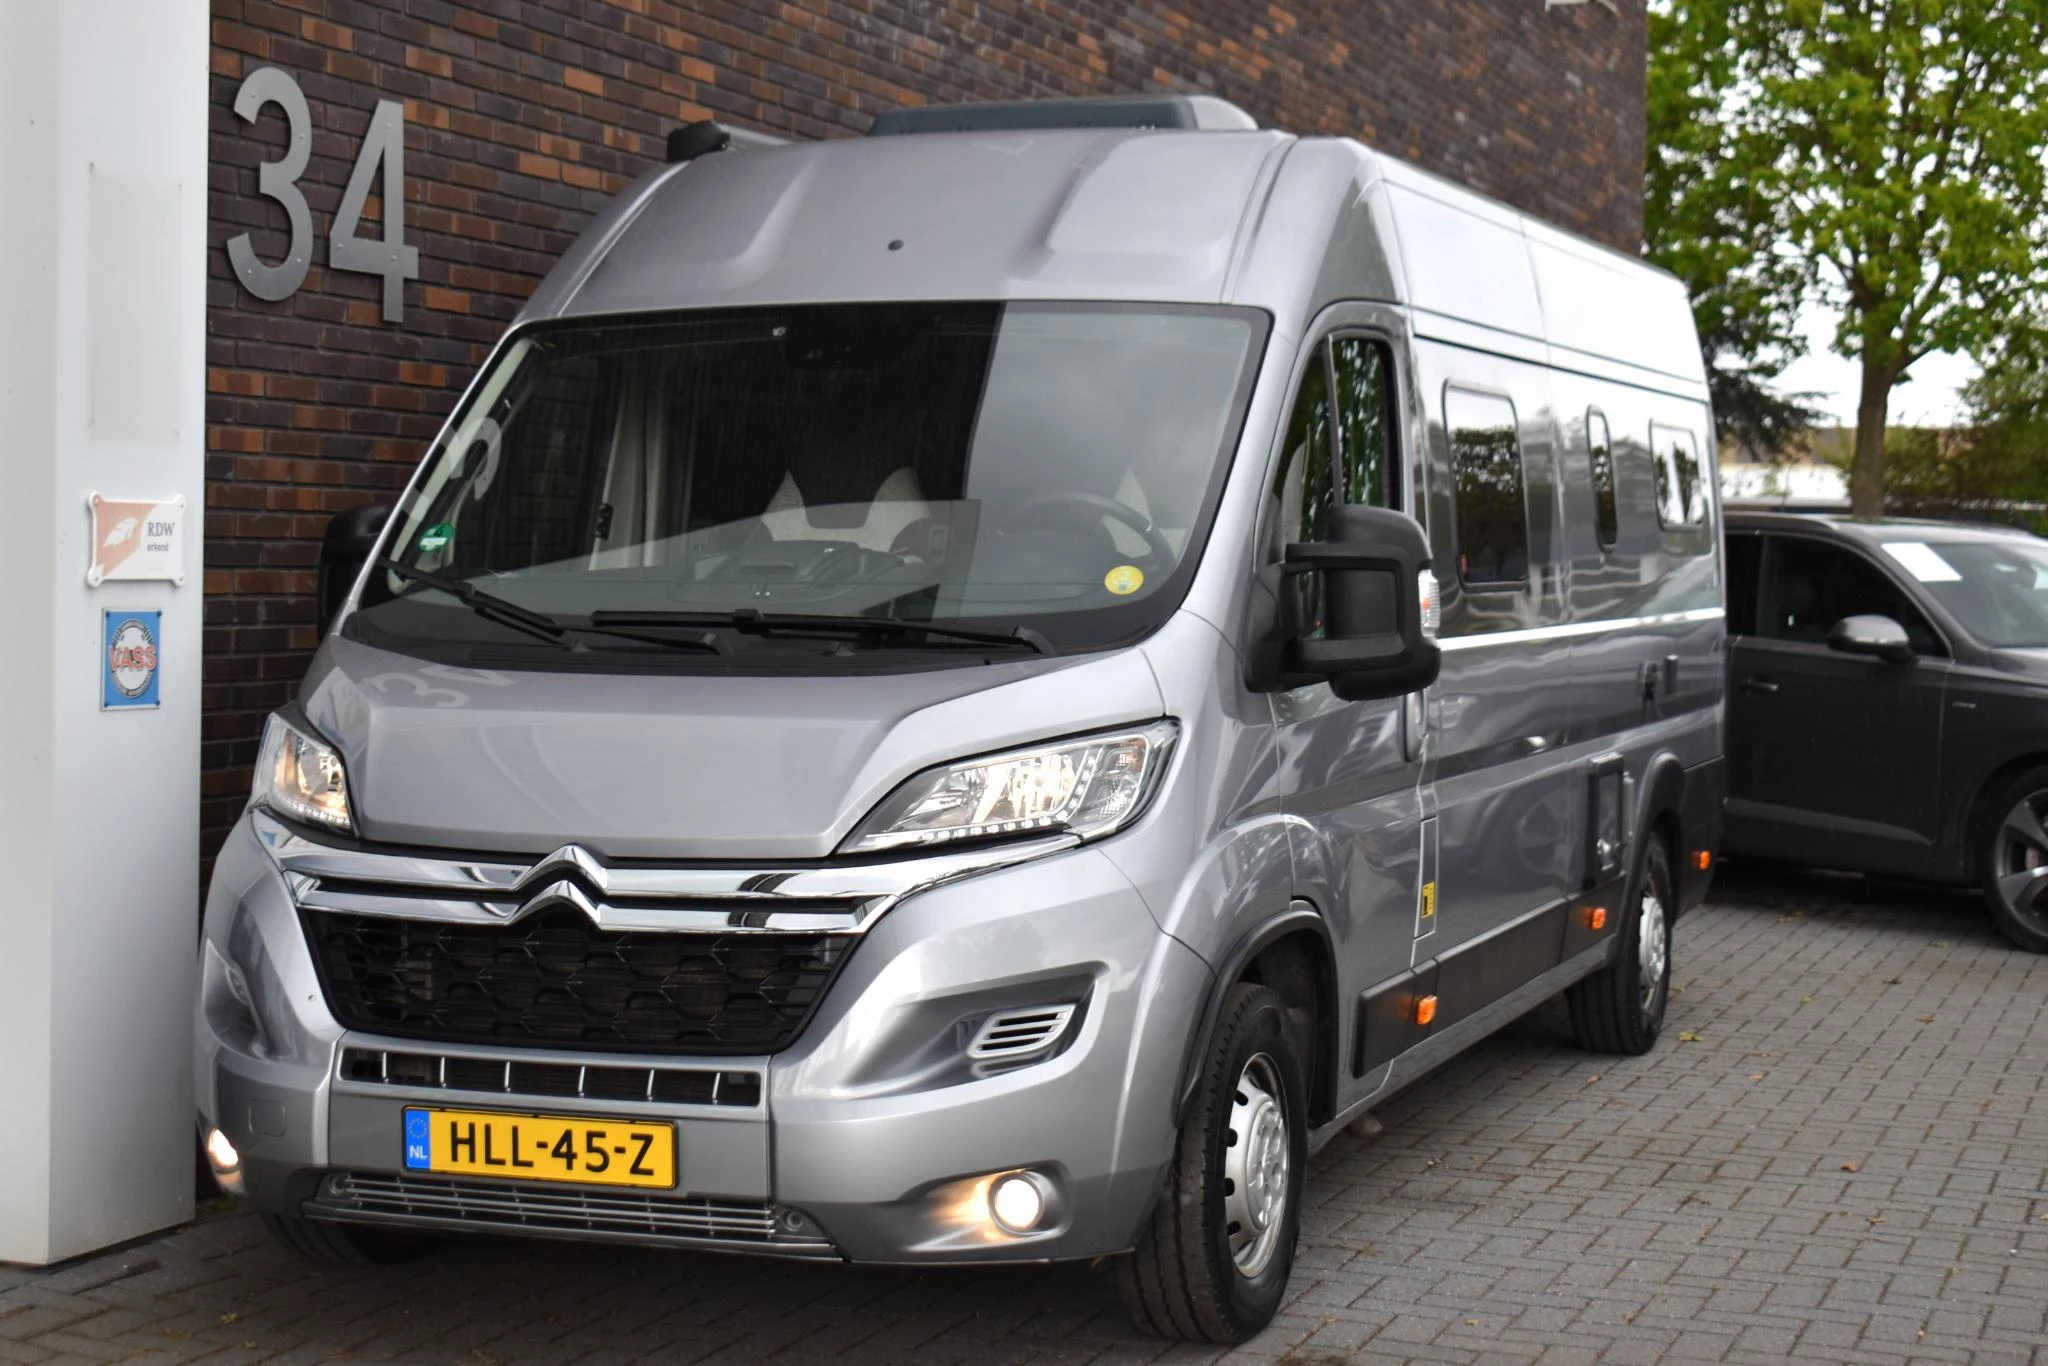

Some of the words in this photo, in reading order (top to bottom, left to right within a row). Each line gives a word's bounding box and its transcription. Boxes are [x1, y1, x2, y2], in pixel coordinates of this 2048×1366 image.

[227, 66, 419, 323] 34
[147, 521, 176, 537] RDW
[409, 1145, 428, 1160] NL
[450, 1121, 655, 1176] HLL-45-Z
